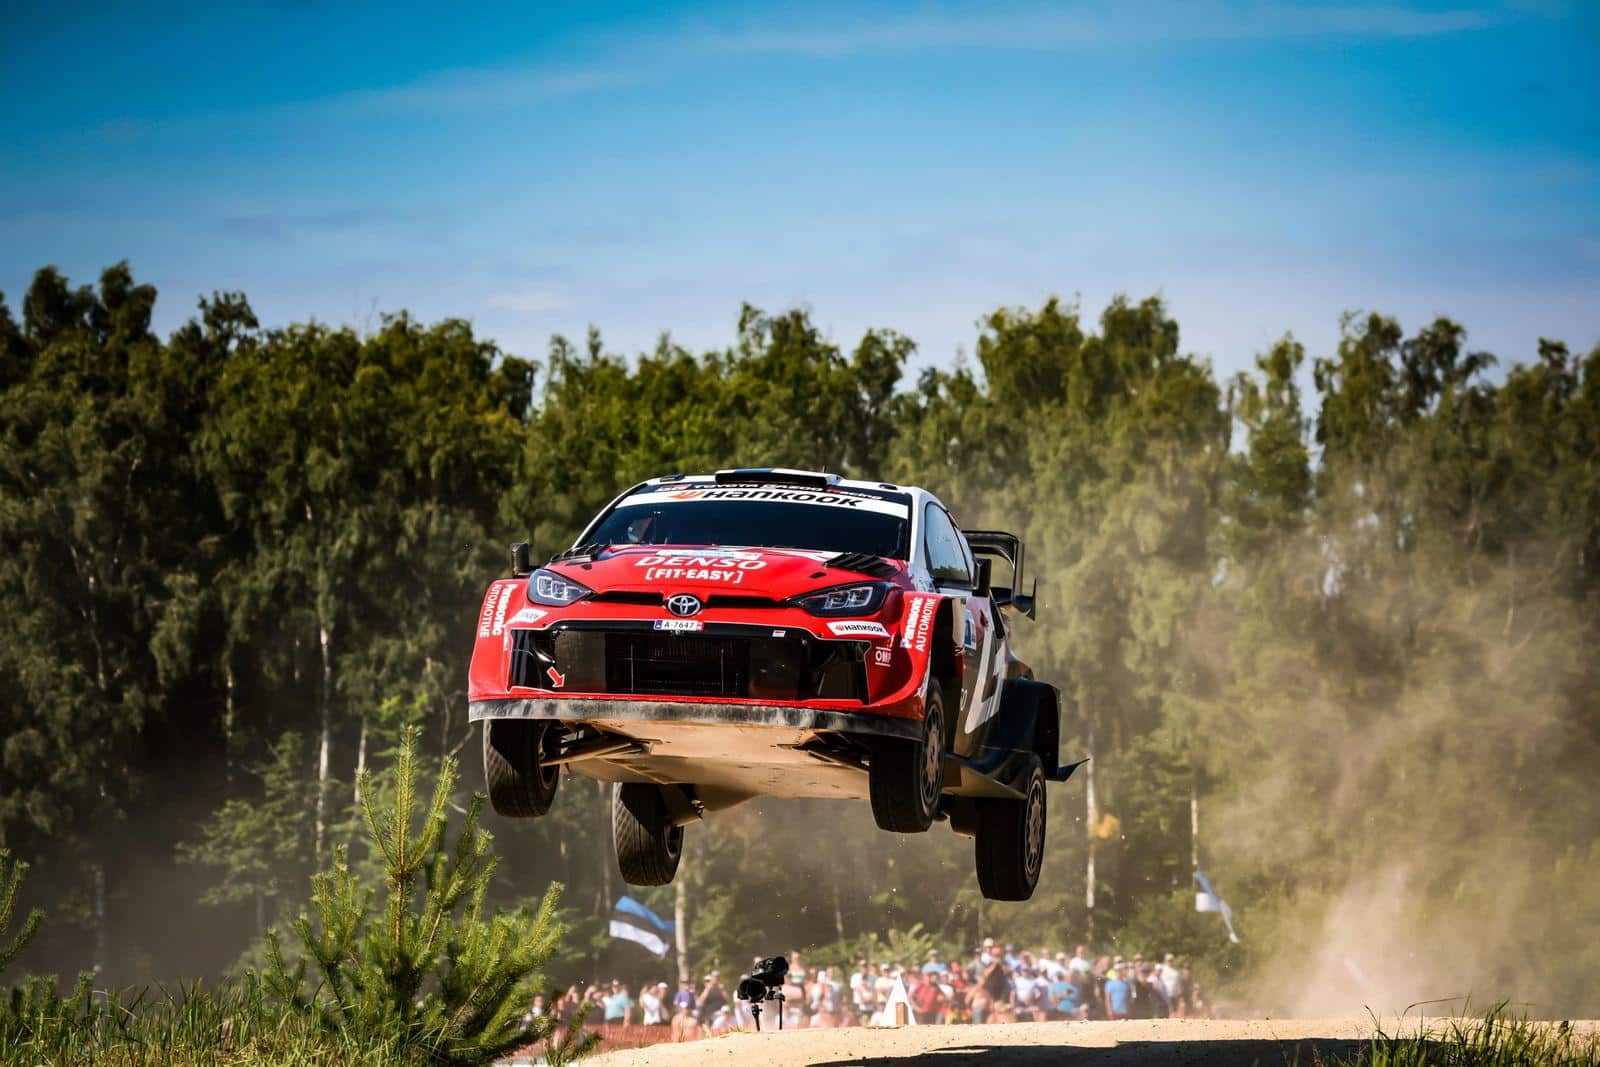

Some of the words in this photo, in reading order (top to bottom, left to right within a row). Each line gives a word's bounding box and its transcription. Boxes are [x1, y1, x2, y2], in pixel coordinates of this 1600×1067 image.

[634, 556, 768, 570] DENSO
[480, 584, 502, 638] AUTOMOTIVE
[900, 597, 923, 649] Panasonic
[915, 598, 937, 652] AUTOMOTIVE
[875, 650, 892, 664] OMP
